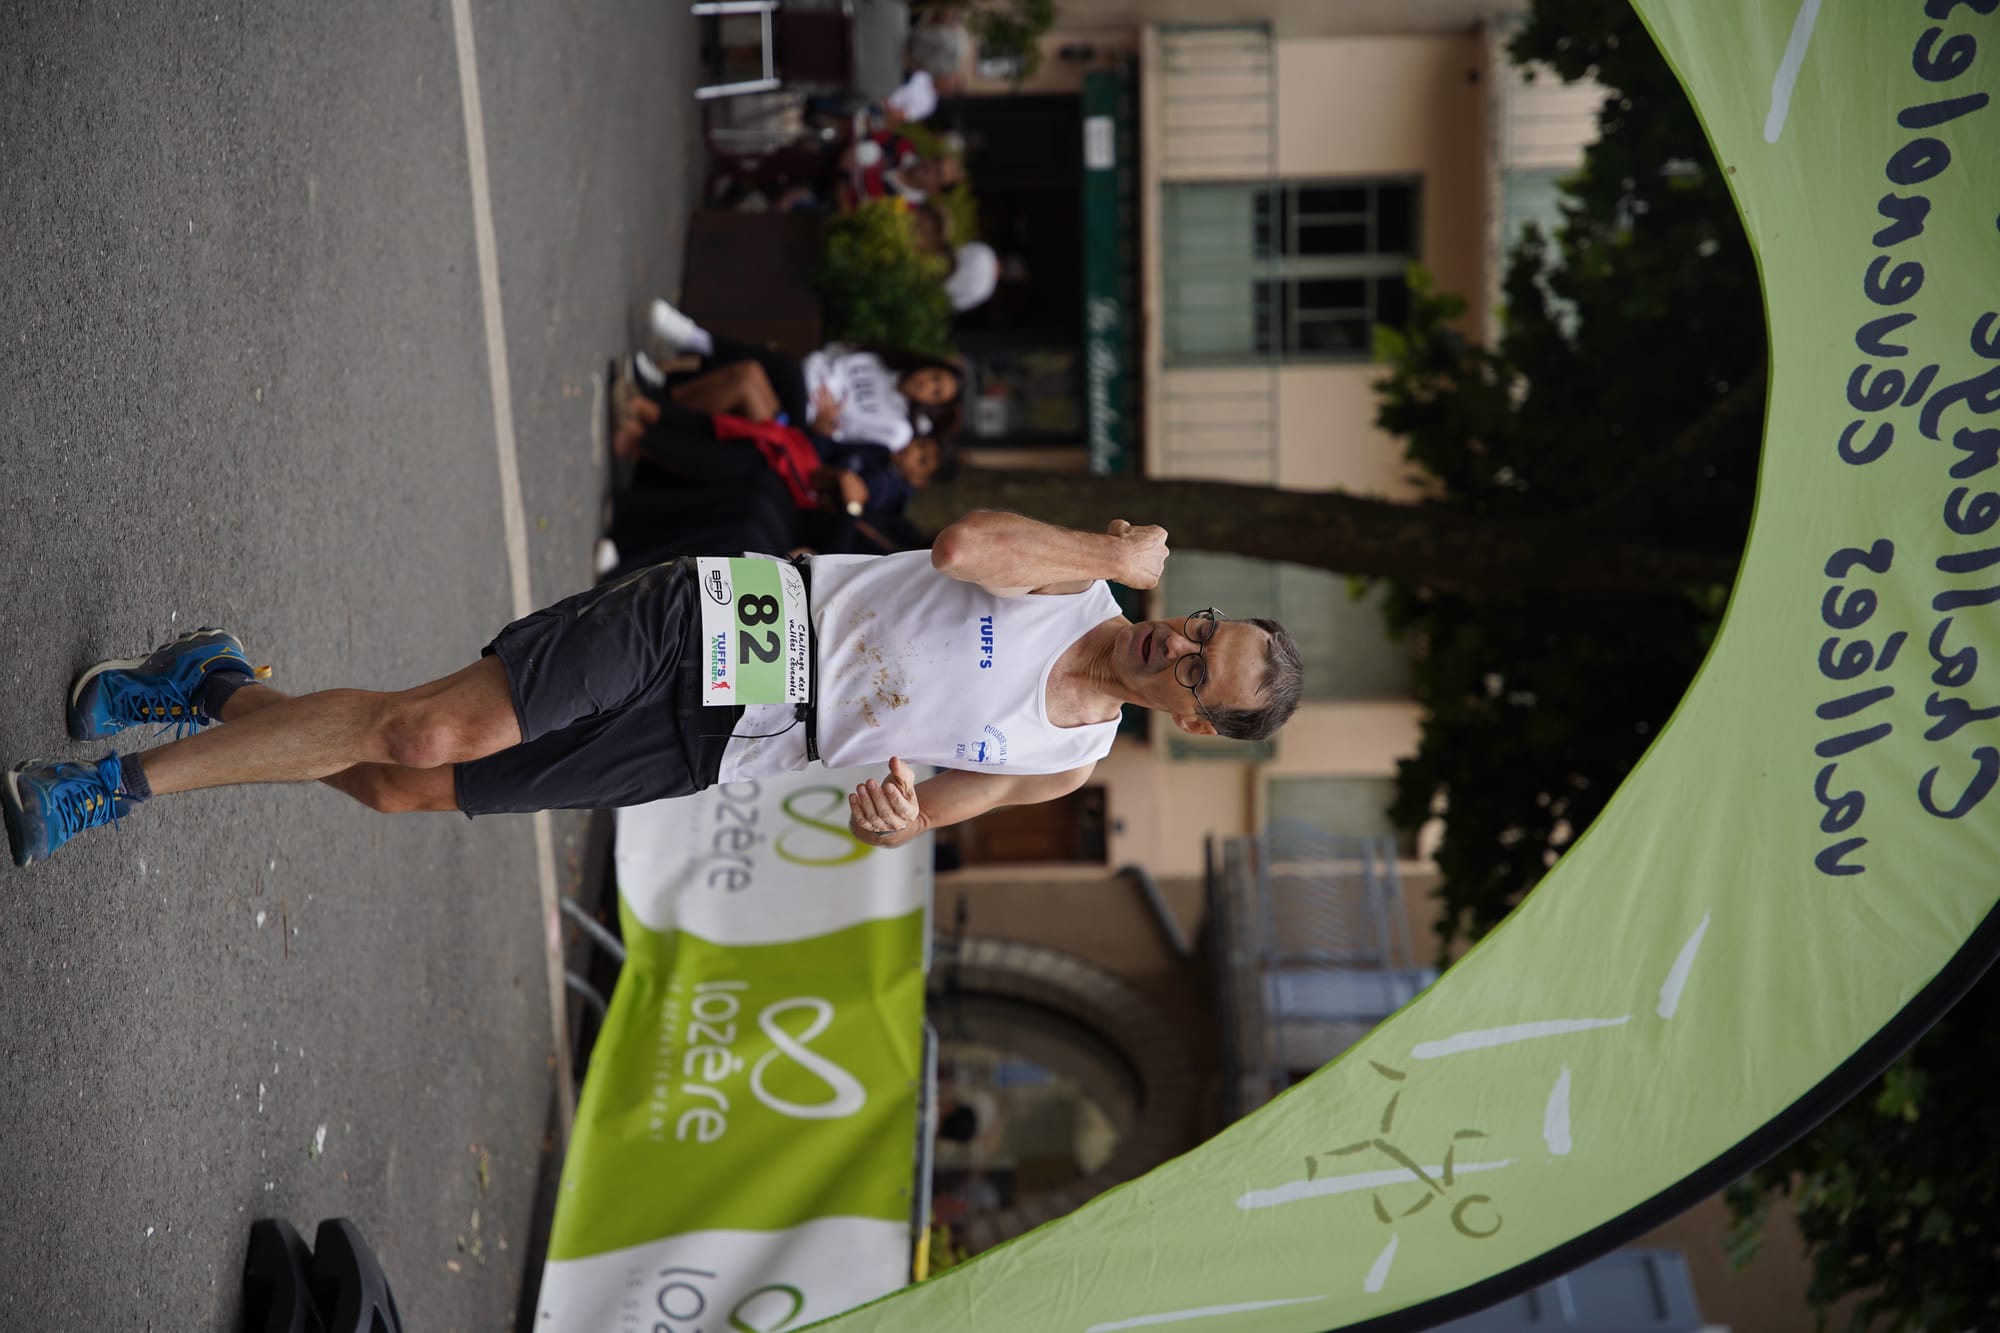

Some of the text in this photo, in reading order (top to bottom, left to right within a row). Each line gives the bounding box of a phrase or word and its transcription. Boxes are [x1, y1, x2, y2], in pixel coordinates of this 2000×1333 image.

[712, 570, 724, 600] BFP
[711, 636, 719, 682] Aventure
[716, 632, 726, 677] TUFF'S
[737, 594, 781, 664] 82
[789, 619, 798, 697] vallées cévenoles
[798, 624, 806, 692] Challenge des
[980, 616, 994, 669] TUFF'S
[708, 780, 767, 893] ozère
[676, 980, 749, 1144] lozère
